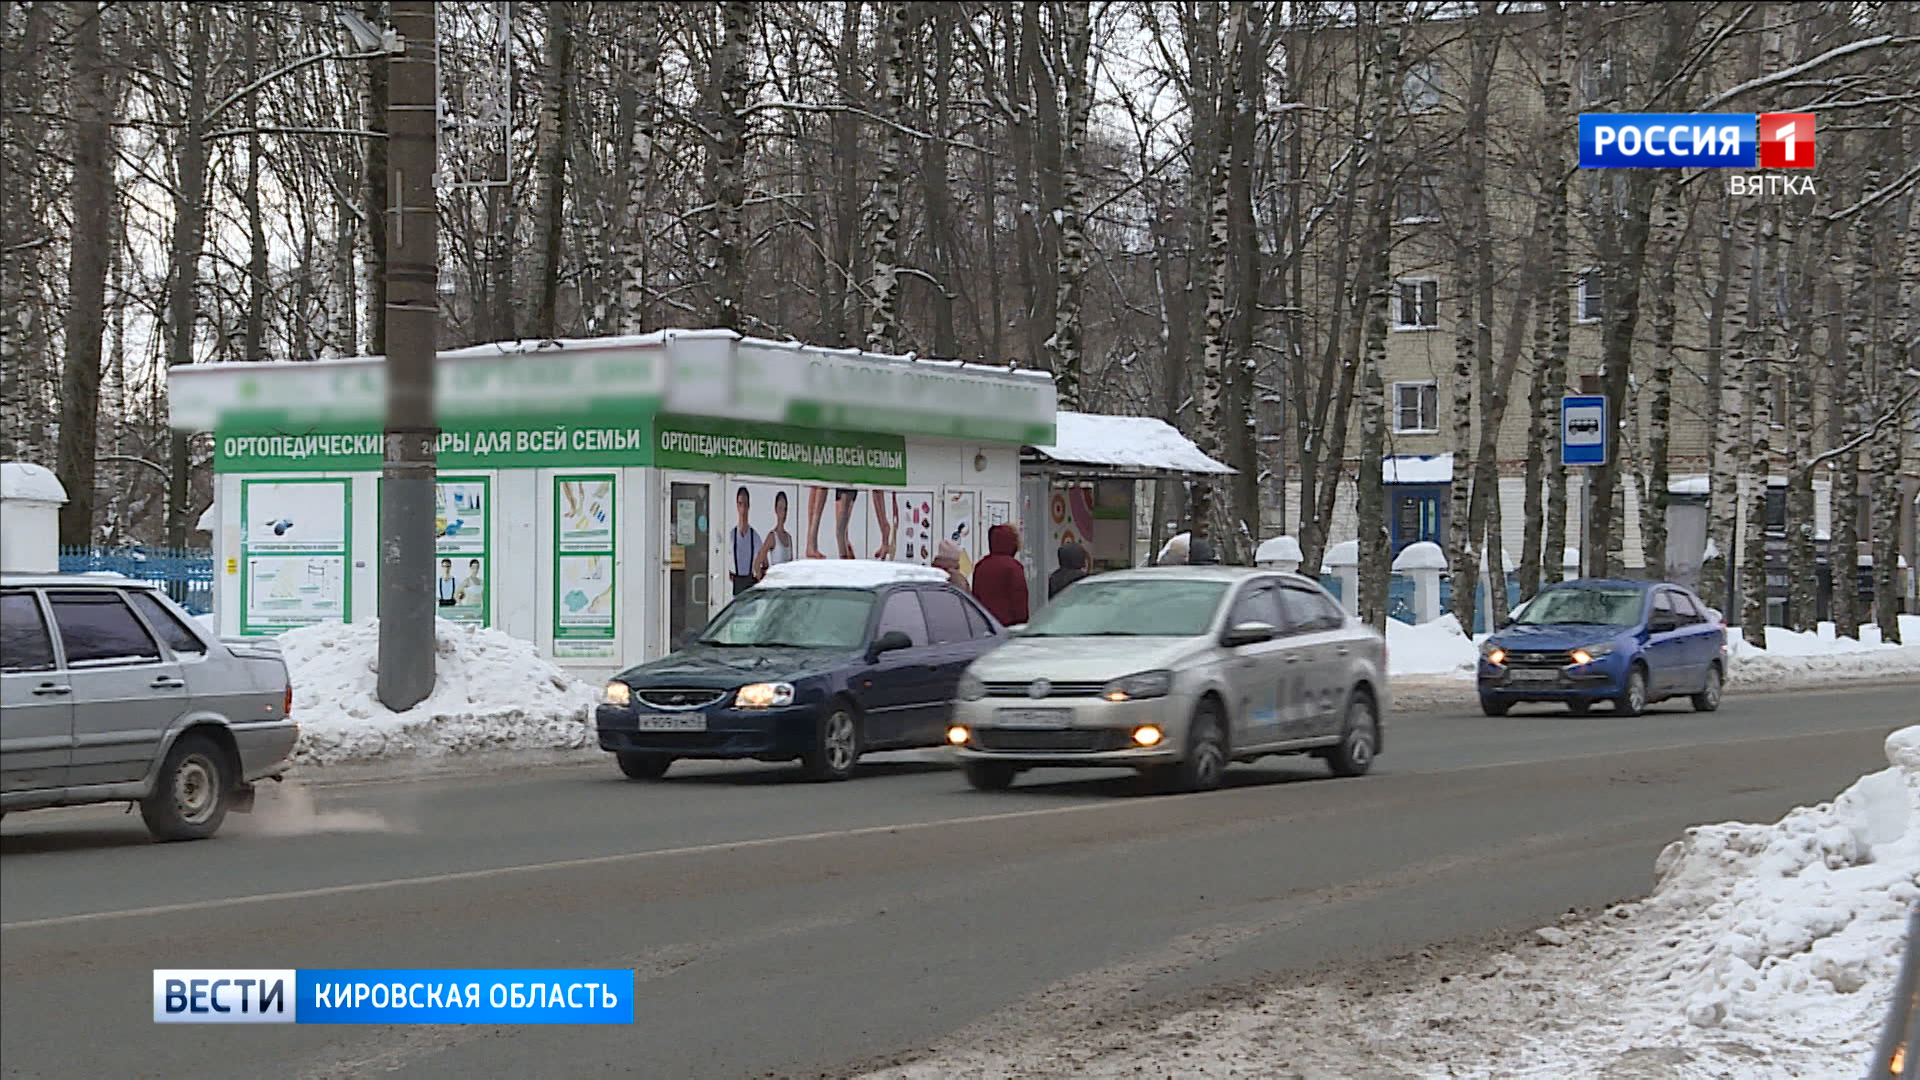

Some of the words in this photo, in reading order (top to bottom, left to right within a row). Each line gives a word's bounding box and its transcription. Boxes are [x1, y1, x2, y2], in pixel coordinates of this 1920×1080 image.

[473, 431, 511, 456] ДЛЯ
[516, 425, 567, 451] ВСЕЙ
[572, 428, 640, 450] СЕМЬИ
[661, 431, 764, 459] ОРТОПЕДИЧЕСКИЕ
[766, 442, 811, 463] ТОВАРЫ
[813, 447, 834, 466] ДЛЯ
[836, 446, 865, 466] ВСЕЙ
[867, 450, 903, 470] СЕМЬИ
